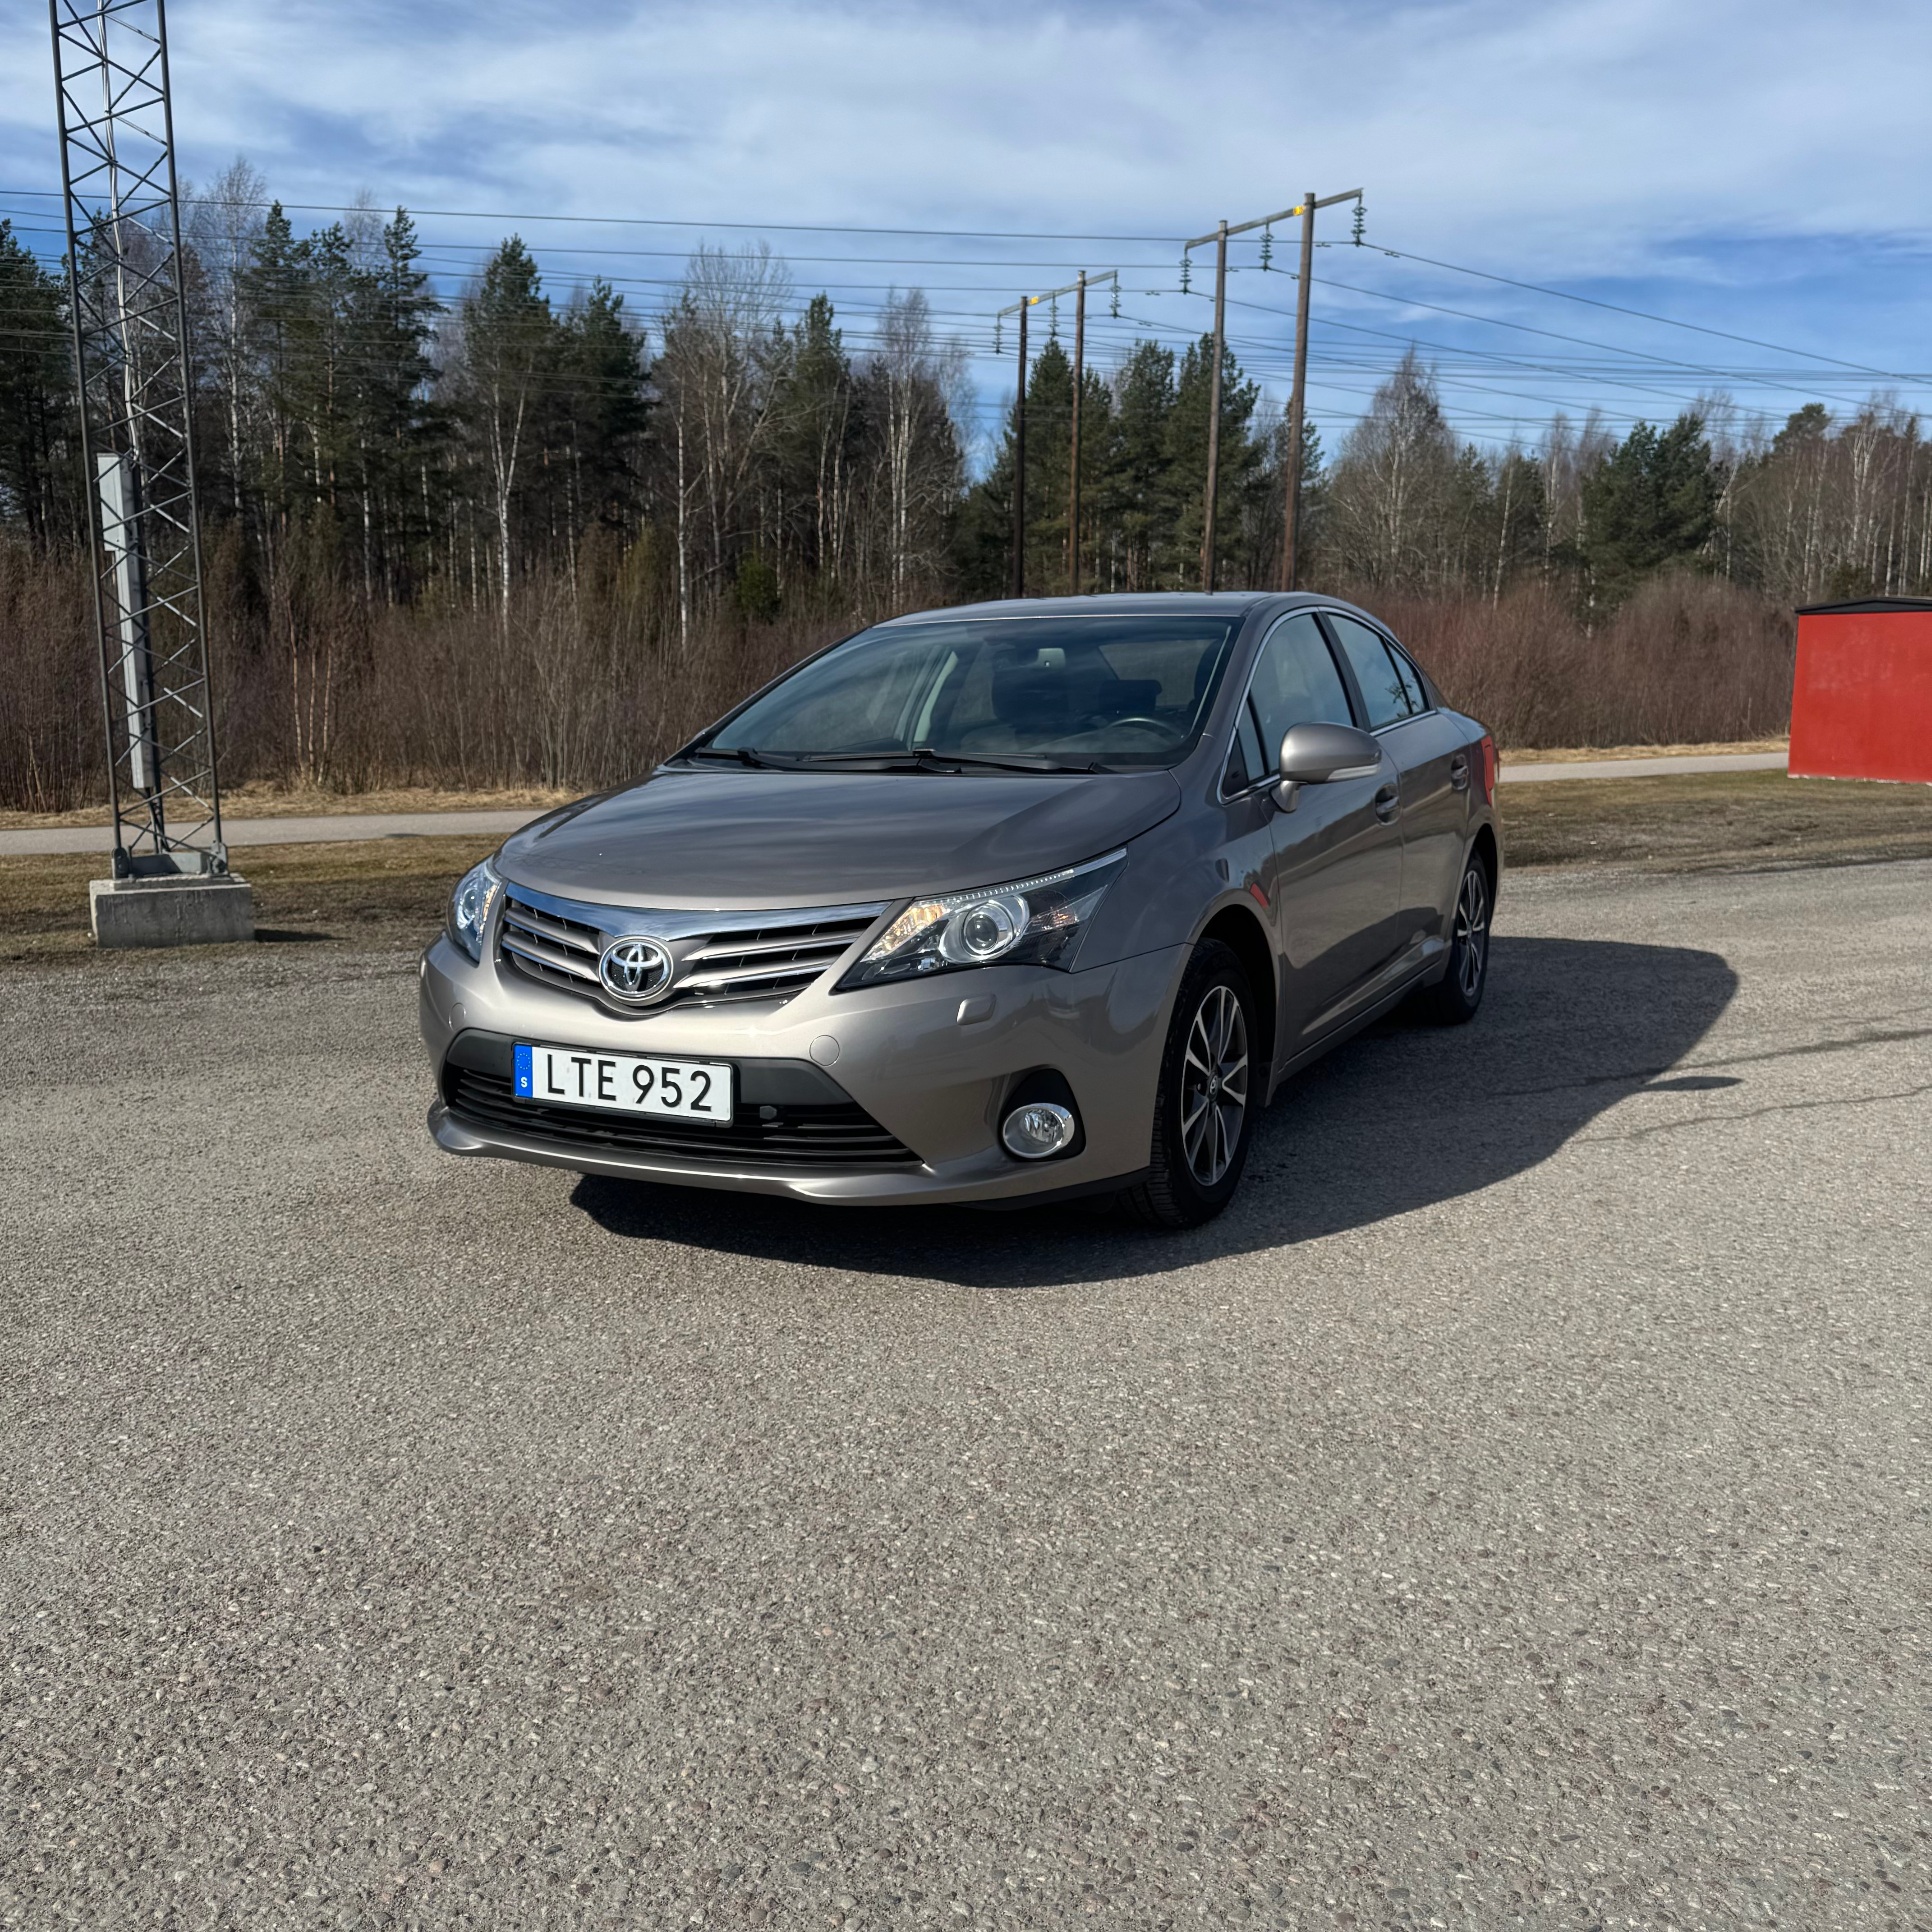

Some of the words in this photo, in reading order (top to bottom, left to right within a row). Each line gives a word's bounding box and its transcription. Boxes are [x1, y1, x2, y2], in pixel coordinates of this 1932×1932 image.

[520, 1076, 528, 1088] S
[547, 1054, 616, 1101] LTE
[632, 1064, 712, 1112] 952
